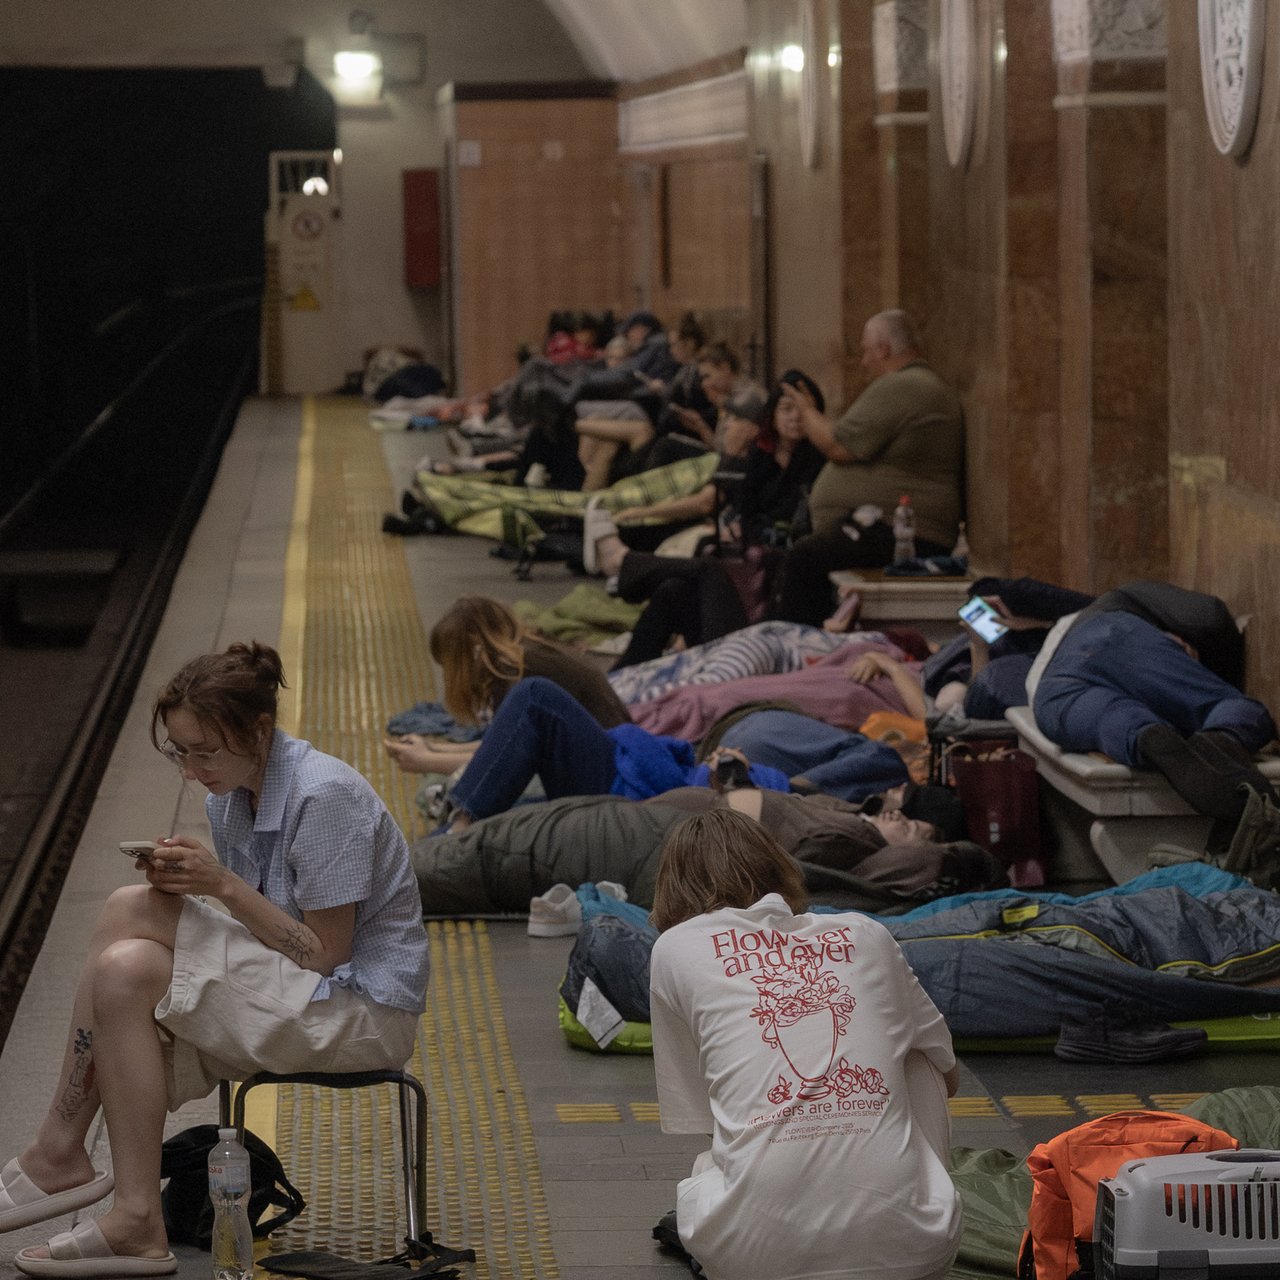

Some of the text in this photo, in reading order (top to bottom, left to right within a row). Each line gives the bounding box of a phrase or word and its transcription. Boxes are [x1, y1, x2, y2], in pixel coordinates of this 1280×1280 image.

[710, 927, 852, 959] Flower
[723, 941, 789, 977] and
[809, 1102, 832, 1114] are
